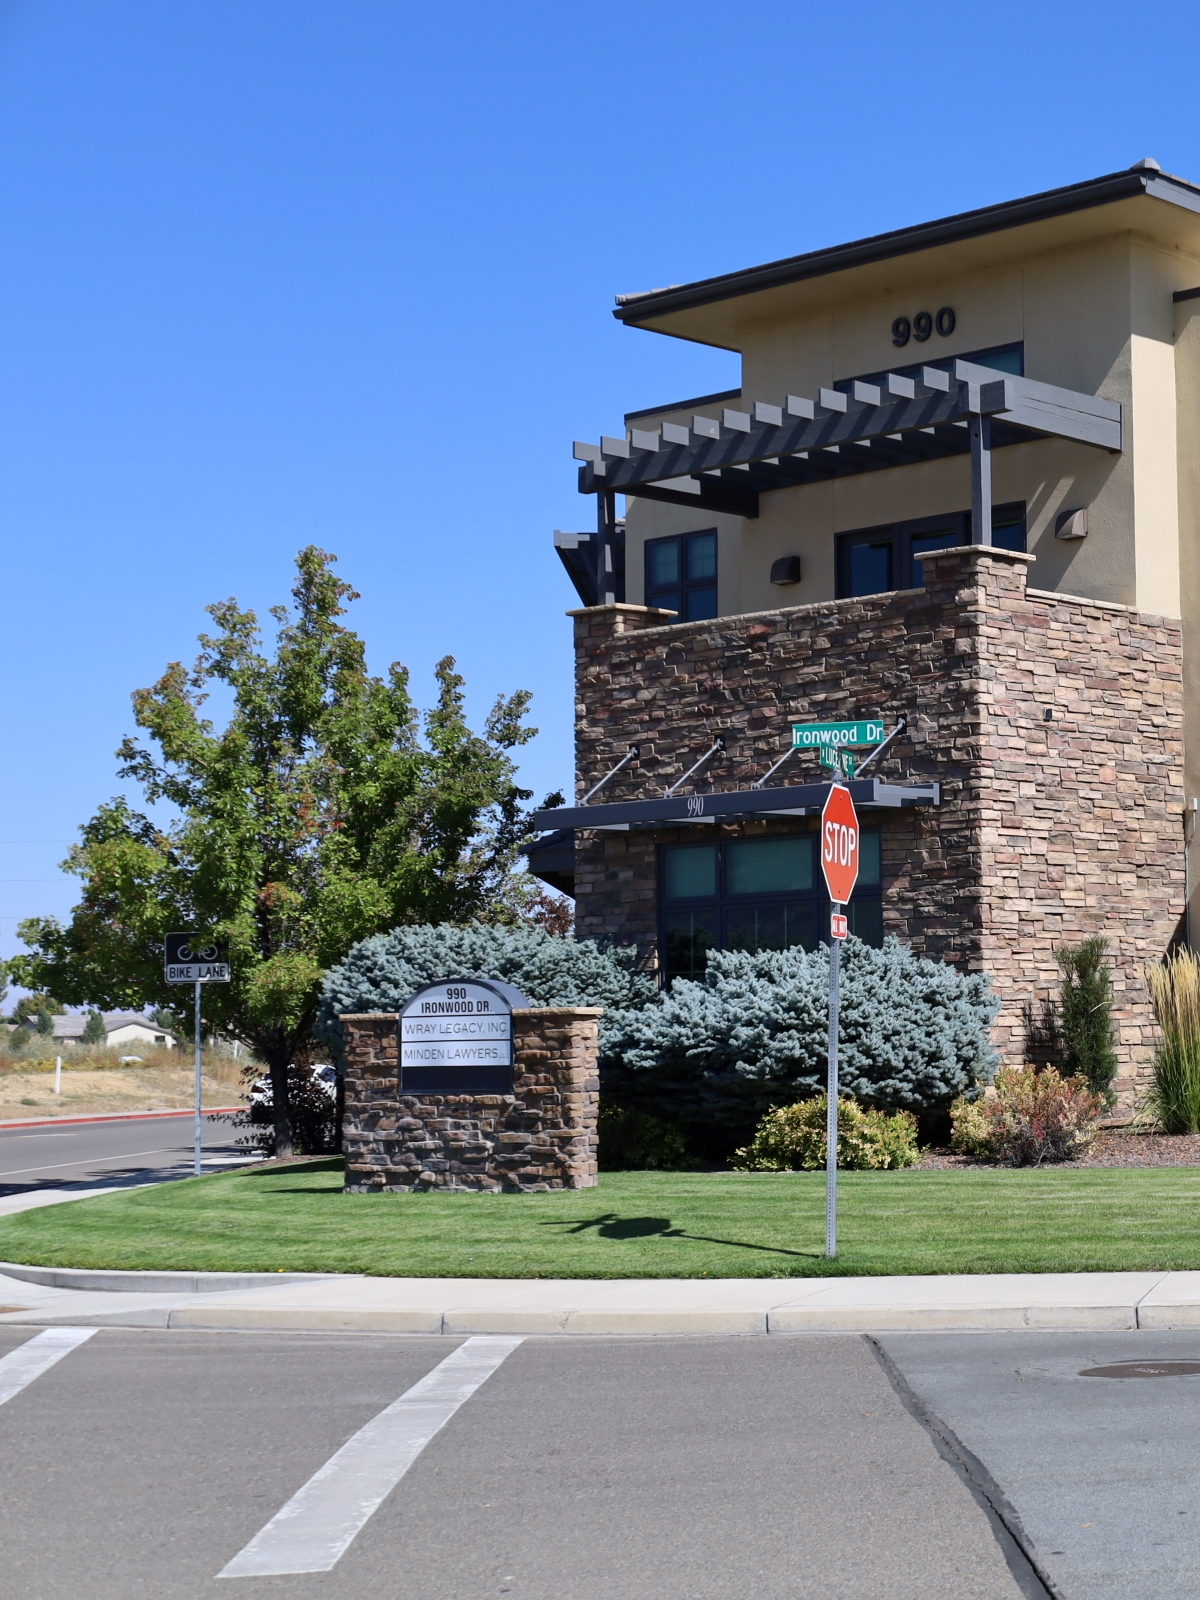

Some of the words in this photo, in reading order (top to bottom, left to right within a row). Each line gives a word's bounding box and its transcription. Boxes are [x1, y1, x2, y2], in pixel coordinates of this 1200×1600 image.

[891, 307, 956, 347] 990
[792, 725, 858, 745] Ironwood
[867, 724, 883, 741] Dr
[687, 796, 704, 817] 990
[825, 821, 856, 867] STOP
[169, 966, 192, 978] BIKE
[198, 965, 226, 978] LANE
[446, 987, 467, 1000] 990
[421, 1001, 474, 1014] IRONWOOD
[476, 1001, 493, 1012] DR.
[404, 1024, 437, 1034] WRAY
[439, 1023, 485, 1034] LEGACY,
[487, 1022, 509, 1033] INC.
[404, 1049, 444, 1060] MINDEN
